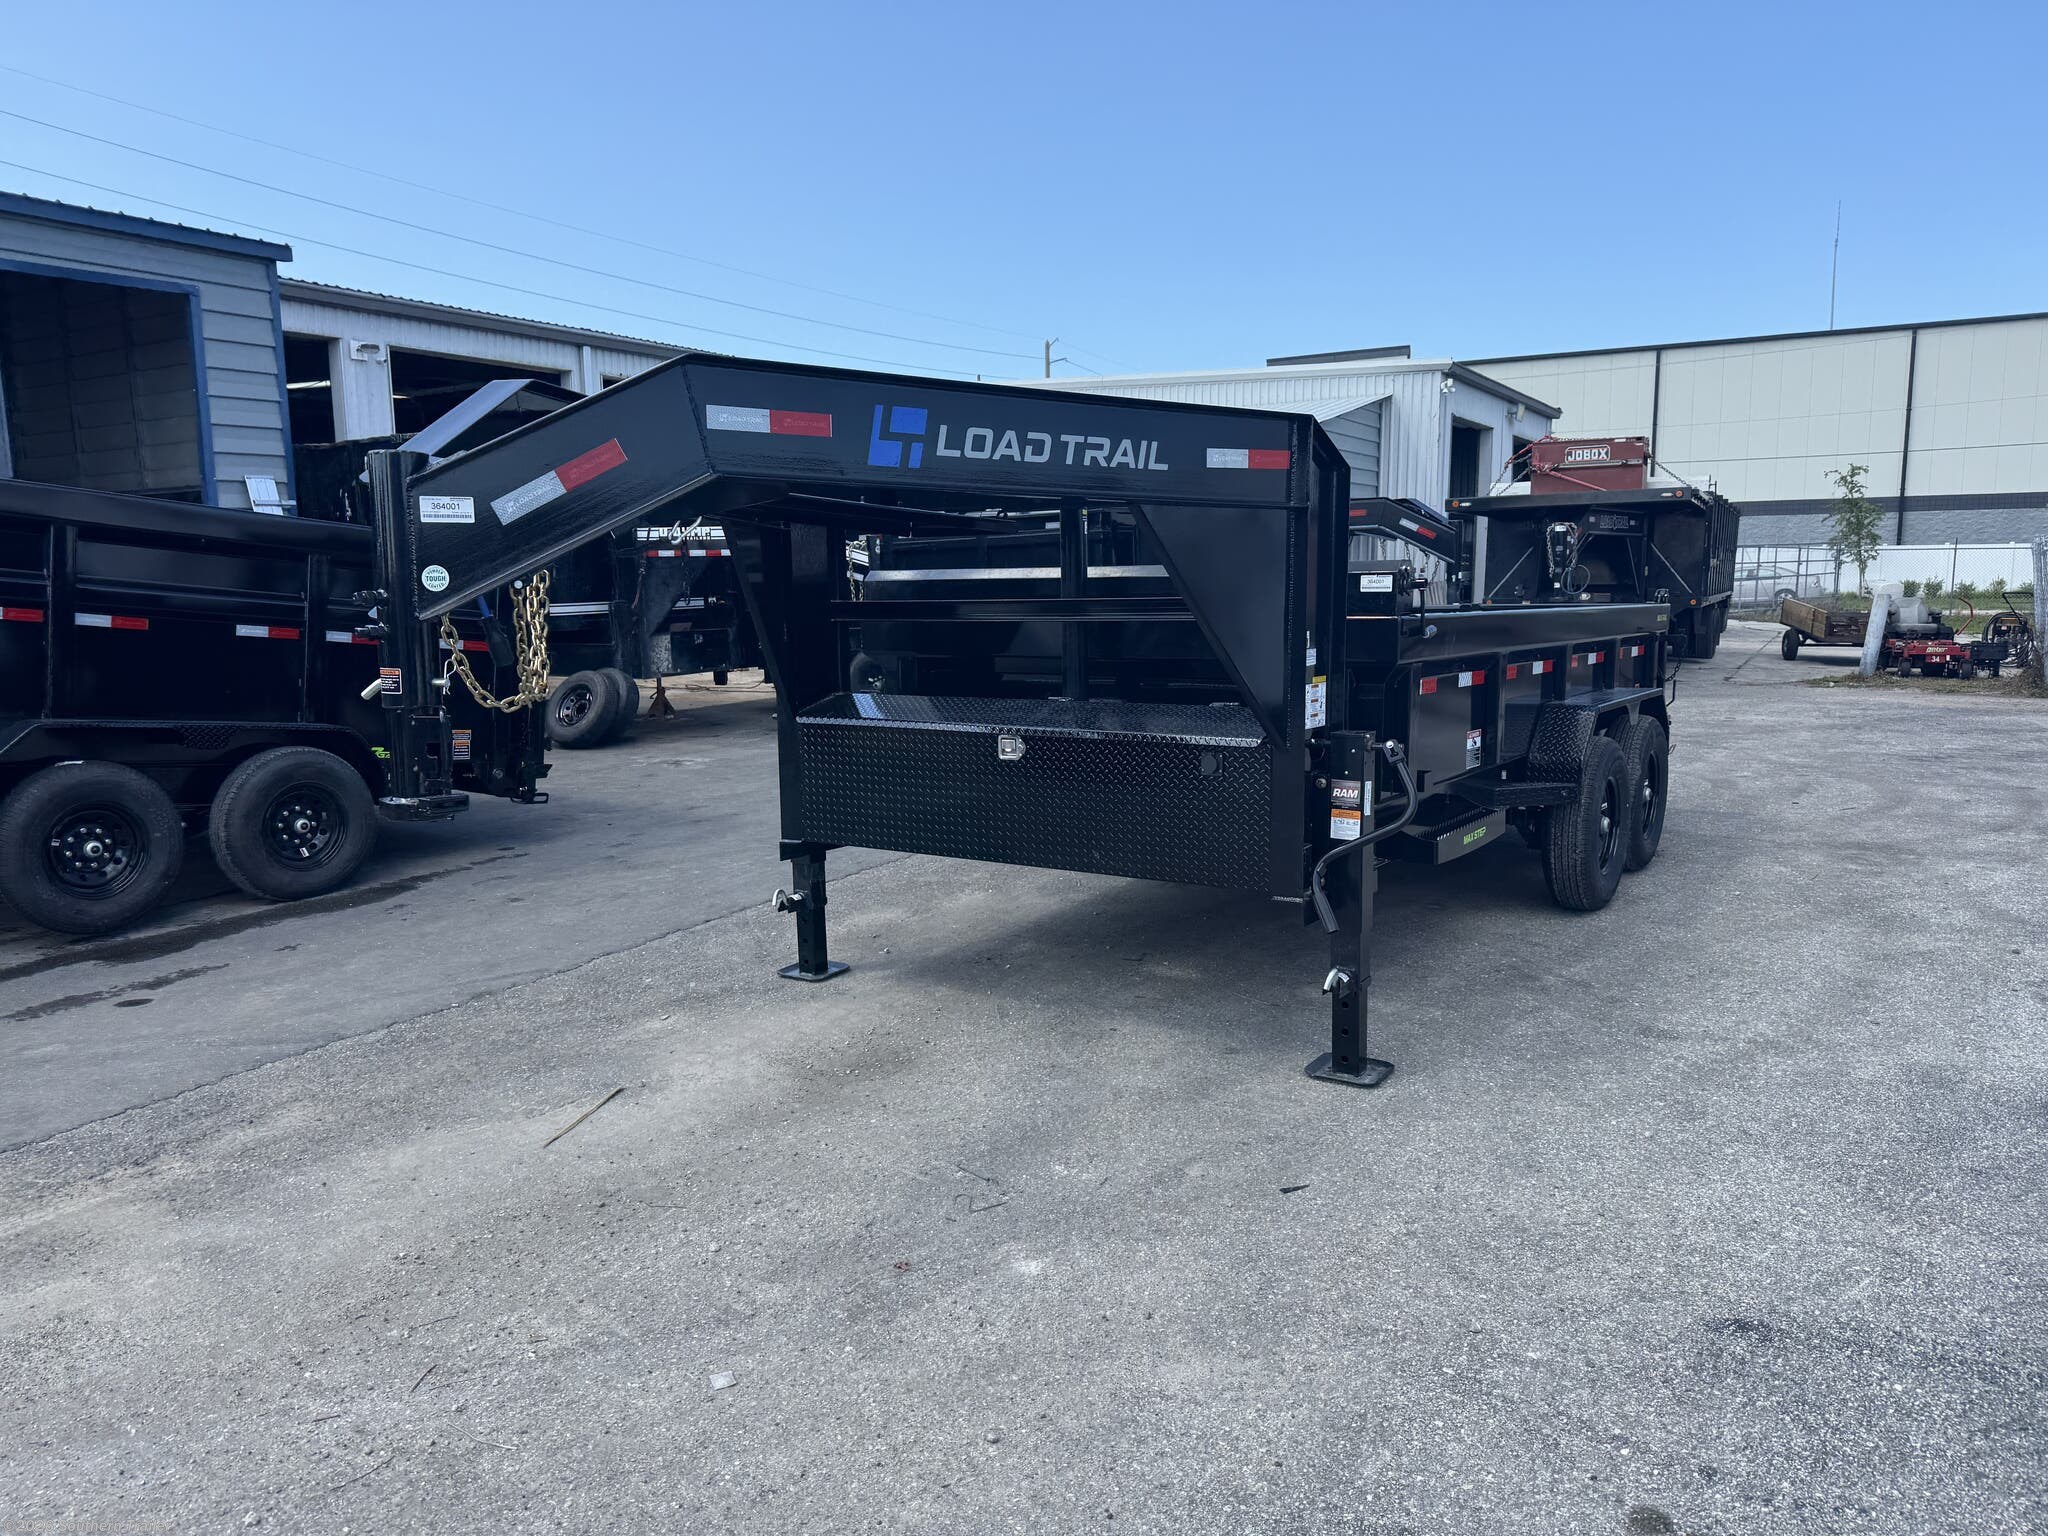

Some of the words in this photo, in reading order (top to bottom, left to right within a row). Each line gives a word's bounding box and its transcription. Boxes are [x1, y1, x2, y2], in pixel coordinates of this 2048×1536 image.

[936, 424, 1053, 463] LOAD
[1060, 434, 1169, 471] TRAIL
[1568, 448, 1607, 460] JOBOX
[431, 502, 461, 510] 364001
[1332, 788, 1359, 799] RAM
[1463, 832, 1474, 845] MAX
[1474, 826, 1486, 840] STEP
